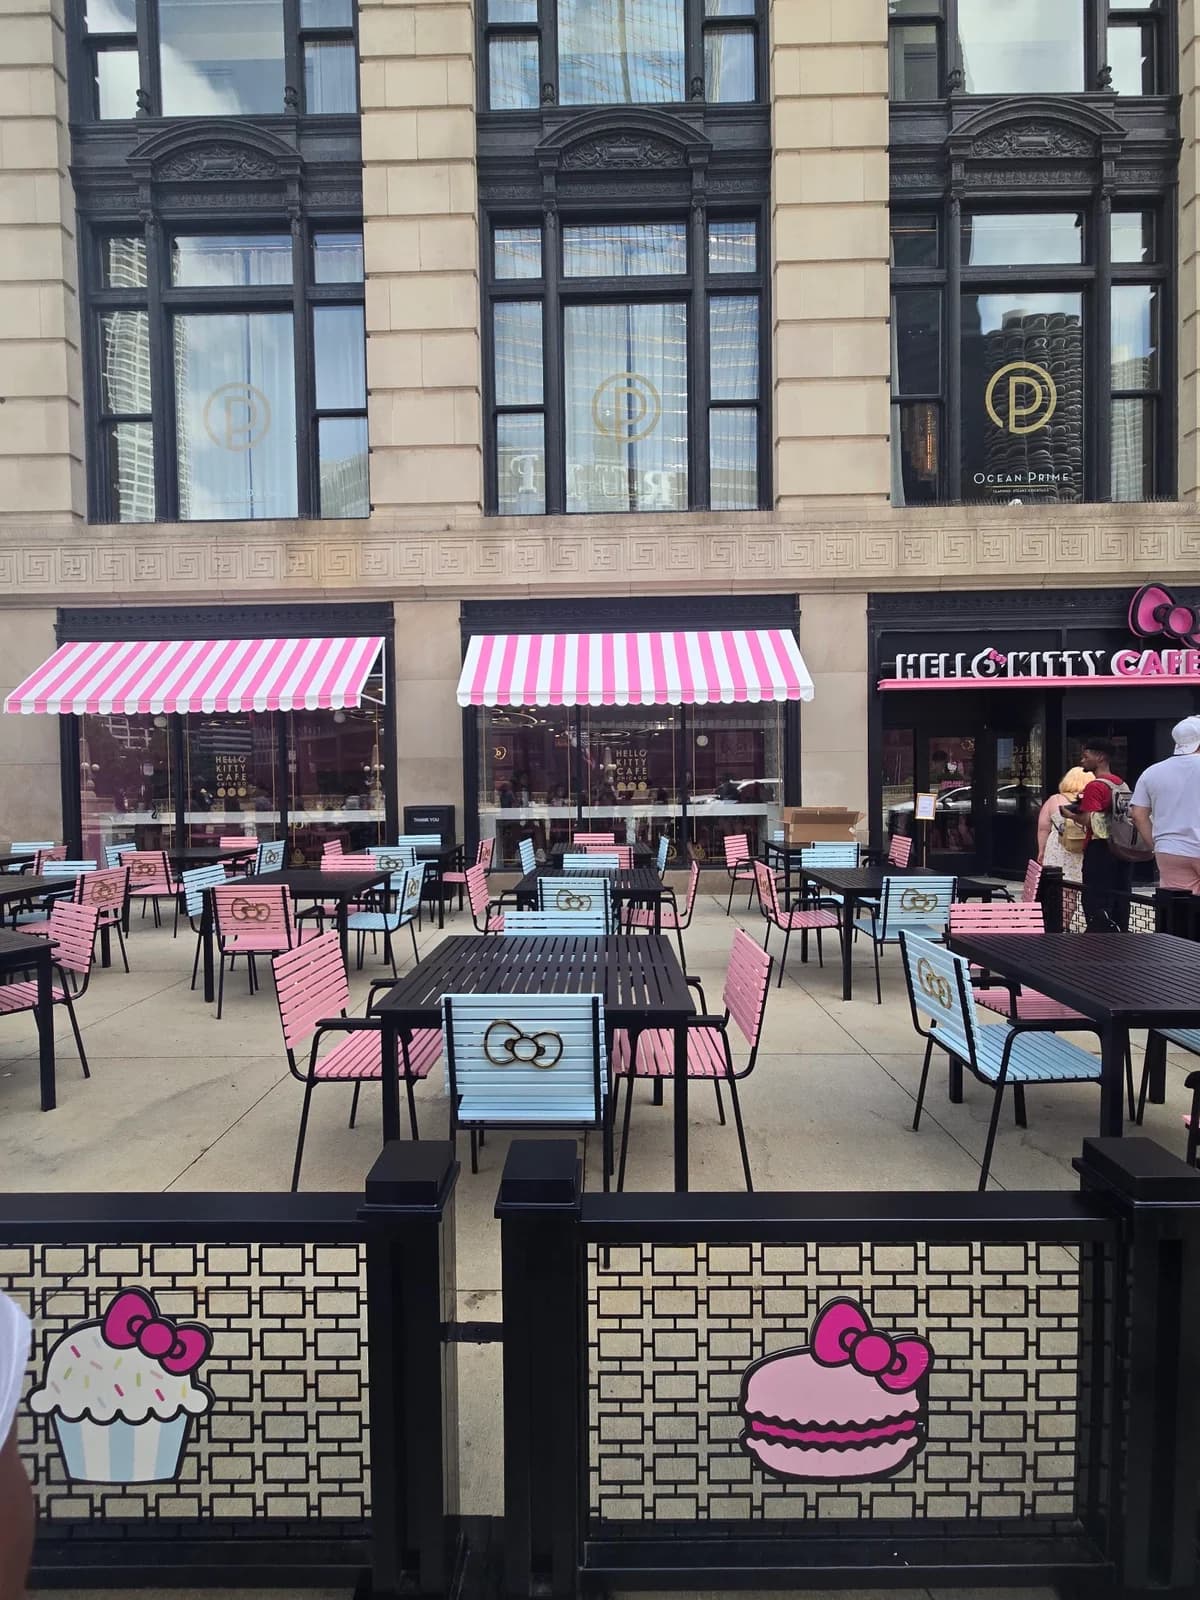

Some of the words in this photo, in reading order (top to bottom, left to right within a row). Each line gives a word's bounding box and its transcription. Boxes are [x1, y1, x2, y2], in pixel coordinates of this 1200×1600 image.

[973, 472, 1022, 484] OCEAN
[1028, 471, 1069, 483] PRIME
[896, 647, 1006, 680] HELLO
[1007, 650, 1106, 679] KITTY
[1110, 649, 1200, 676] CAFE
[616, 749, 648, 758] HELLO
[215, 755, 246, 764] HELLO
[616, 758, 647, 767] KITTY
[216, 764, 246, 773] KITTY
[616, 767, 647, 776] CAFE
[216, 773, 247, 781] CAFE
